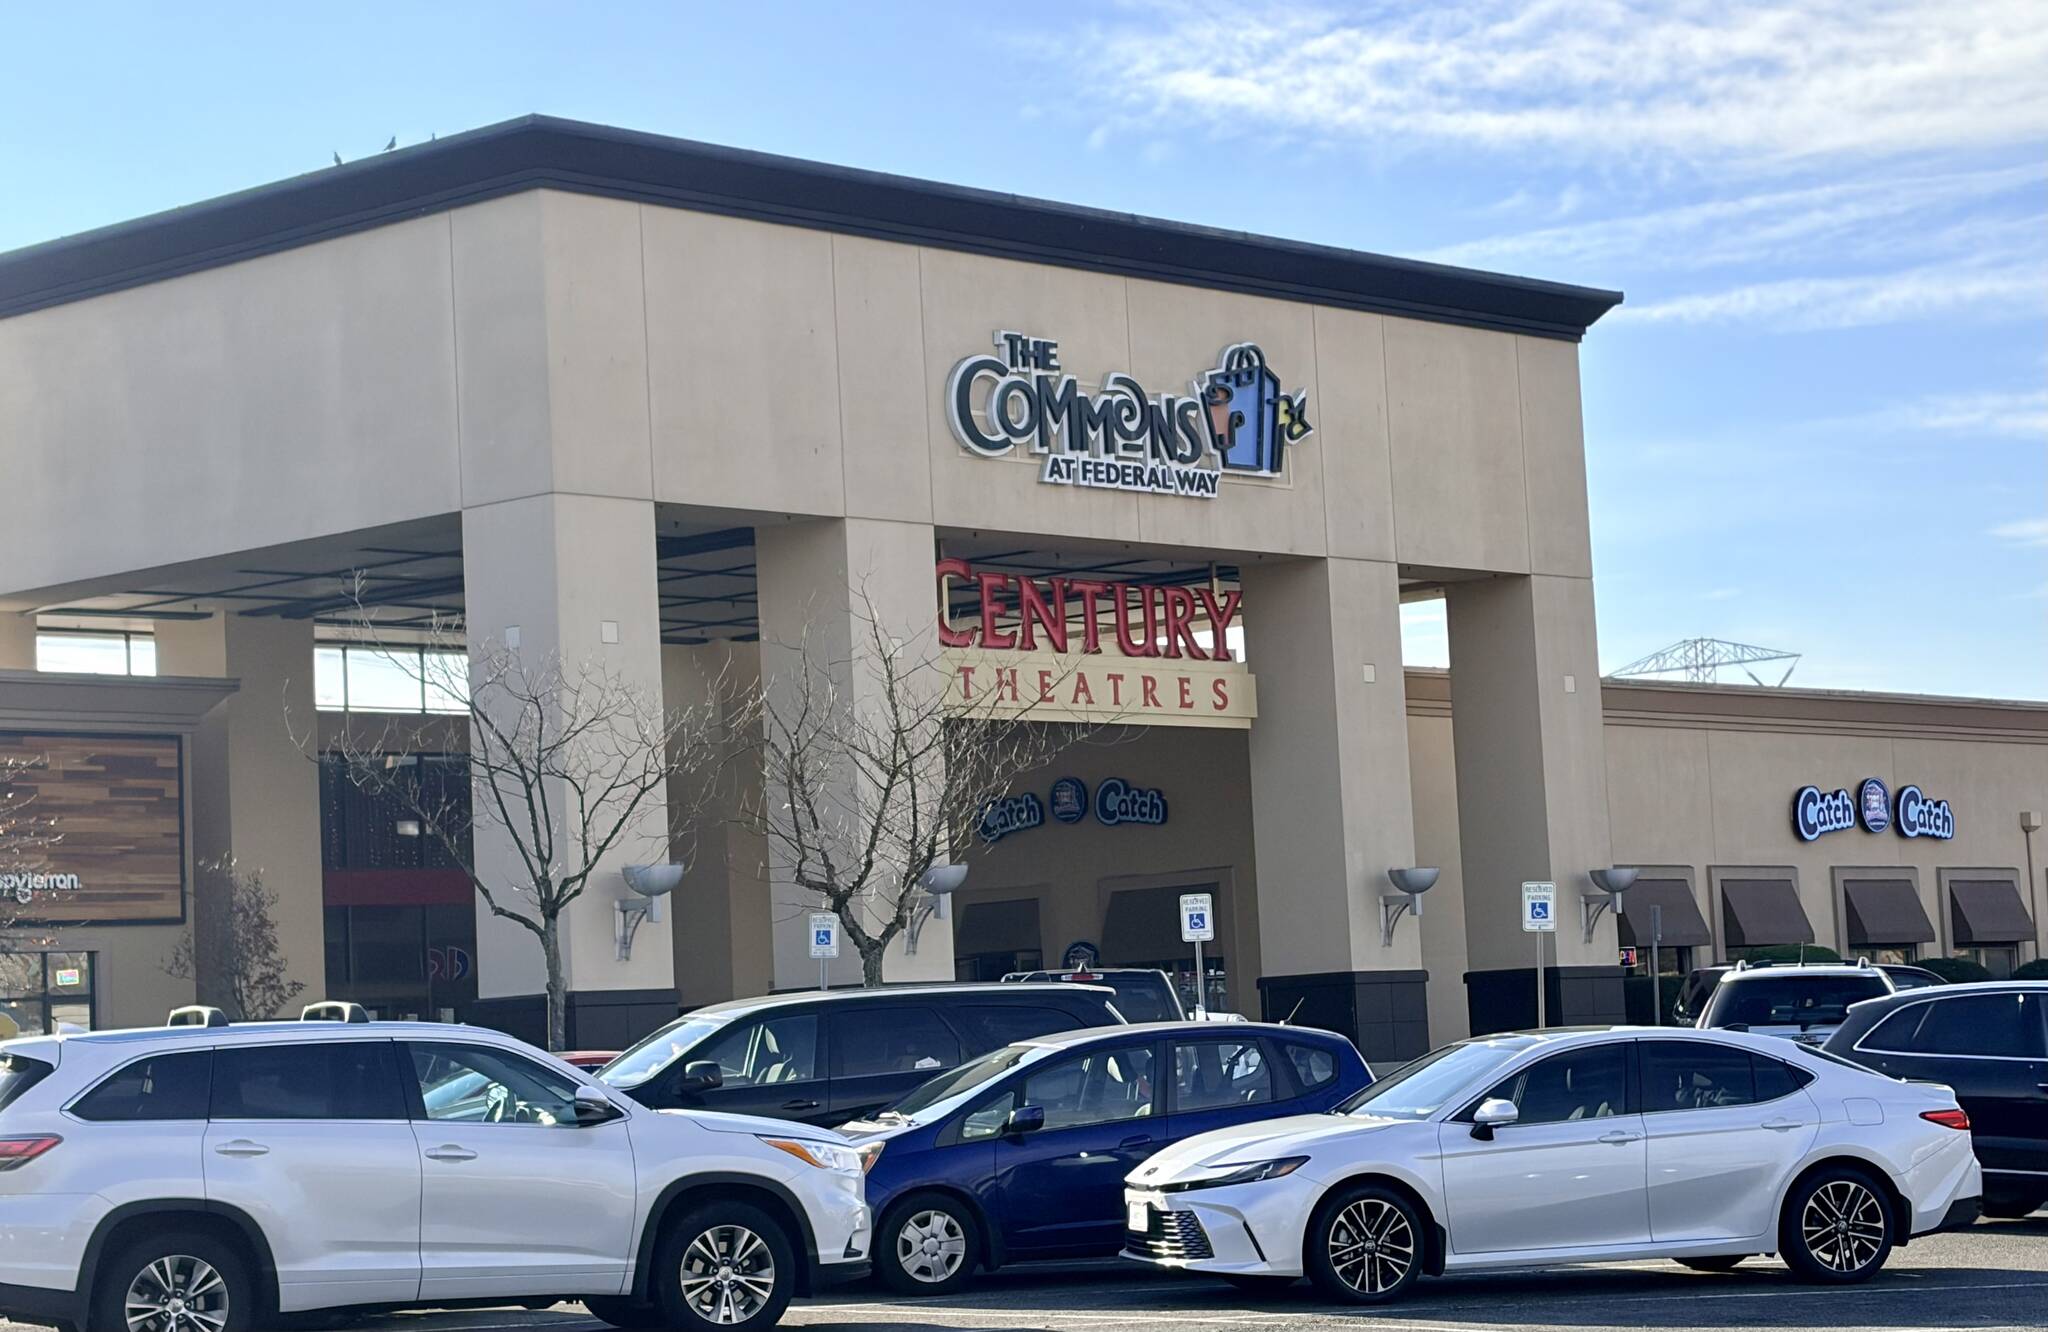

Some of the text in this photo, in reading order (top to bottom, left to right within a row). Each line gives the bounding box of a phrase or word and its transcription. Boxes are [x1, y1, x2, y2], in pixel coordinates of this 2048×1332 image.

[1004, 333, 1060, 371] THE
[956, 358, 1202, 464] COMMONS
[1048, 457, 1220, 494] AT FEDERAL WAY
[936, 558, 1243, 661] CENTURY
[957, 666, 1229, 711] THEATRES
[1096, 780, 1163, 823] Catch
[1799, 787, 1853, 839] Catch
[1900, 787, 1952, 837] Catch
